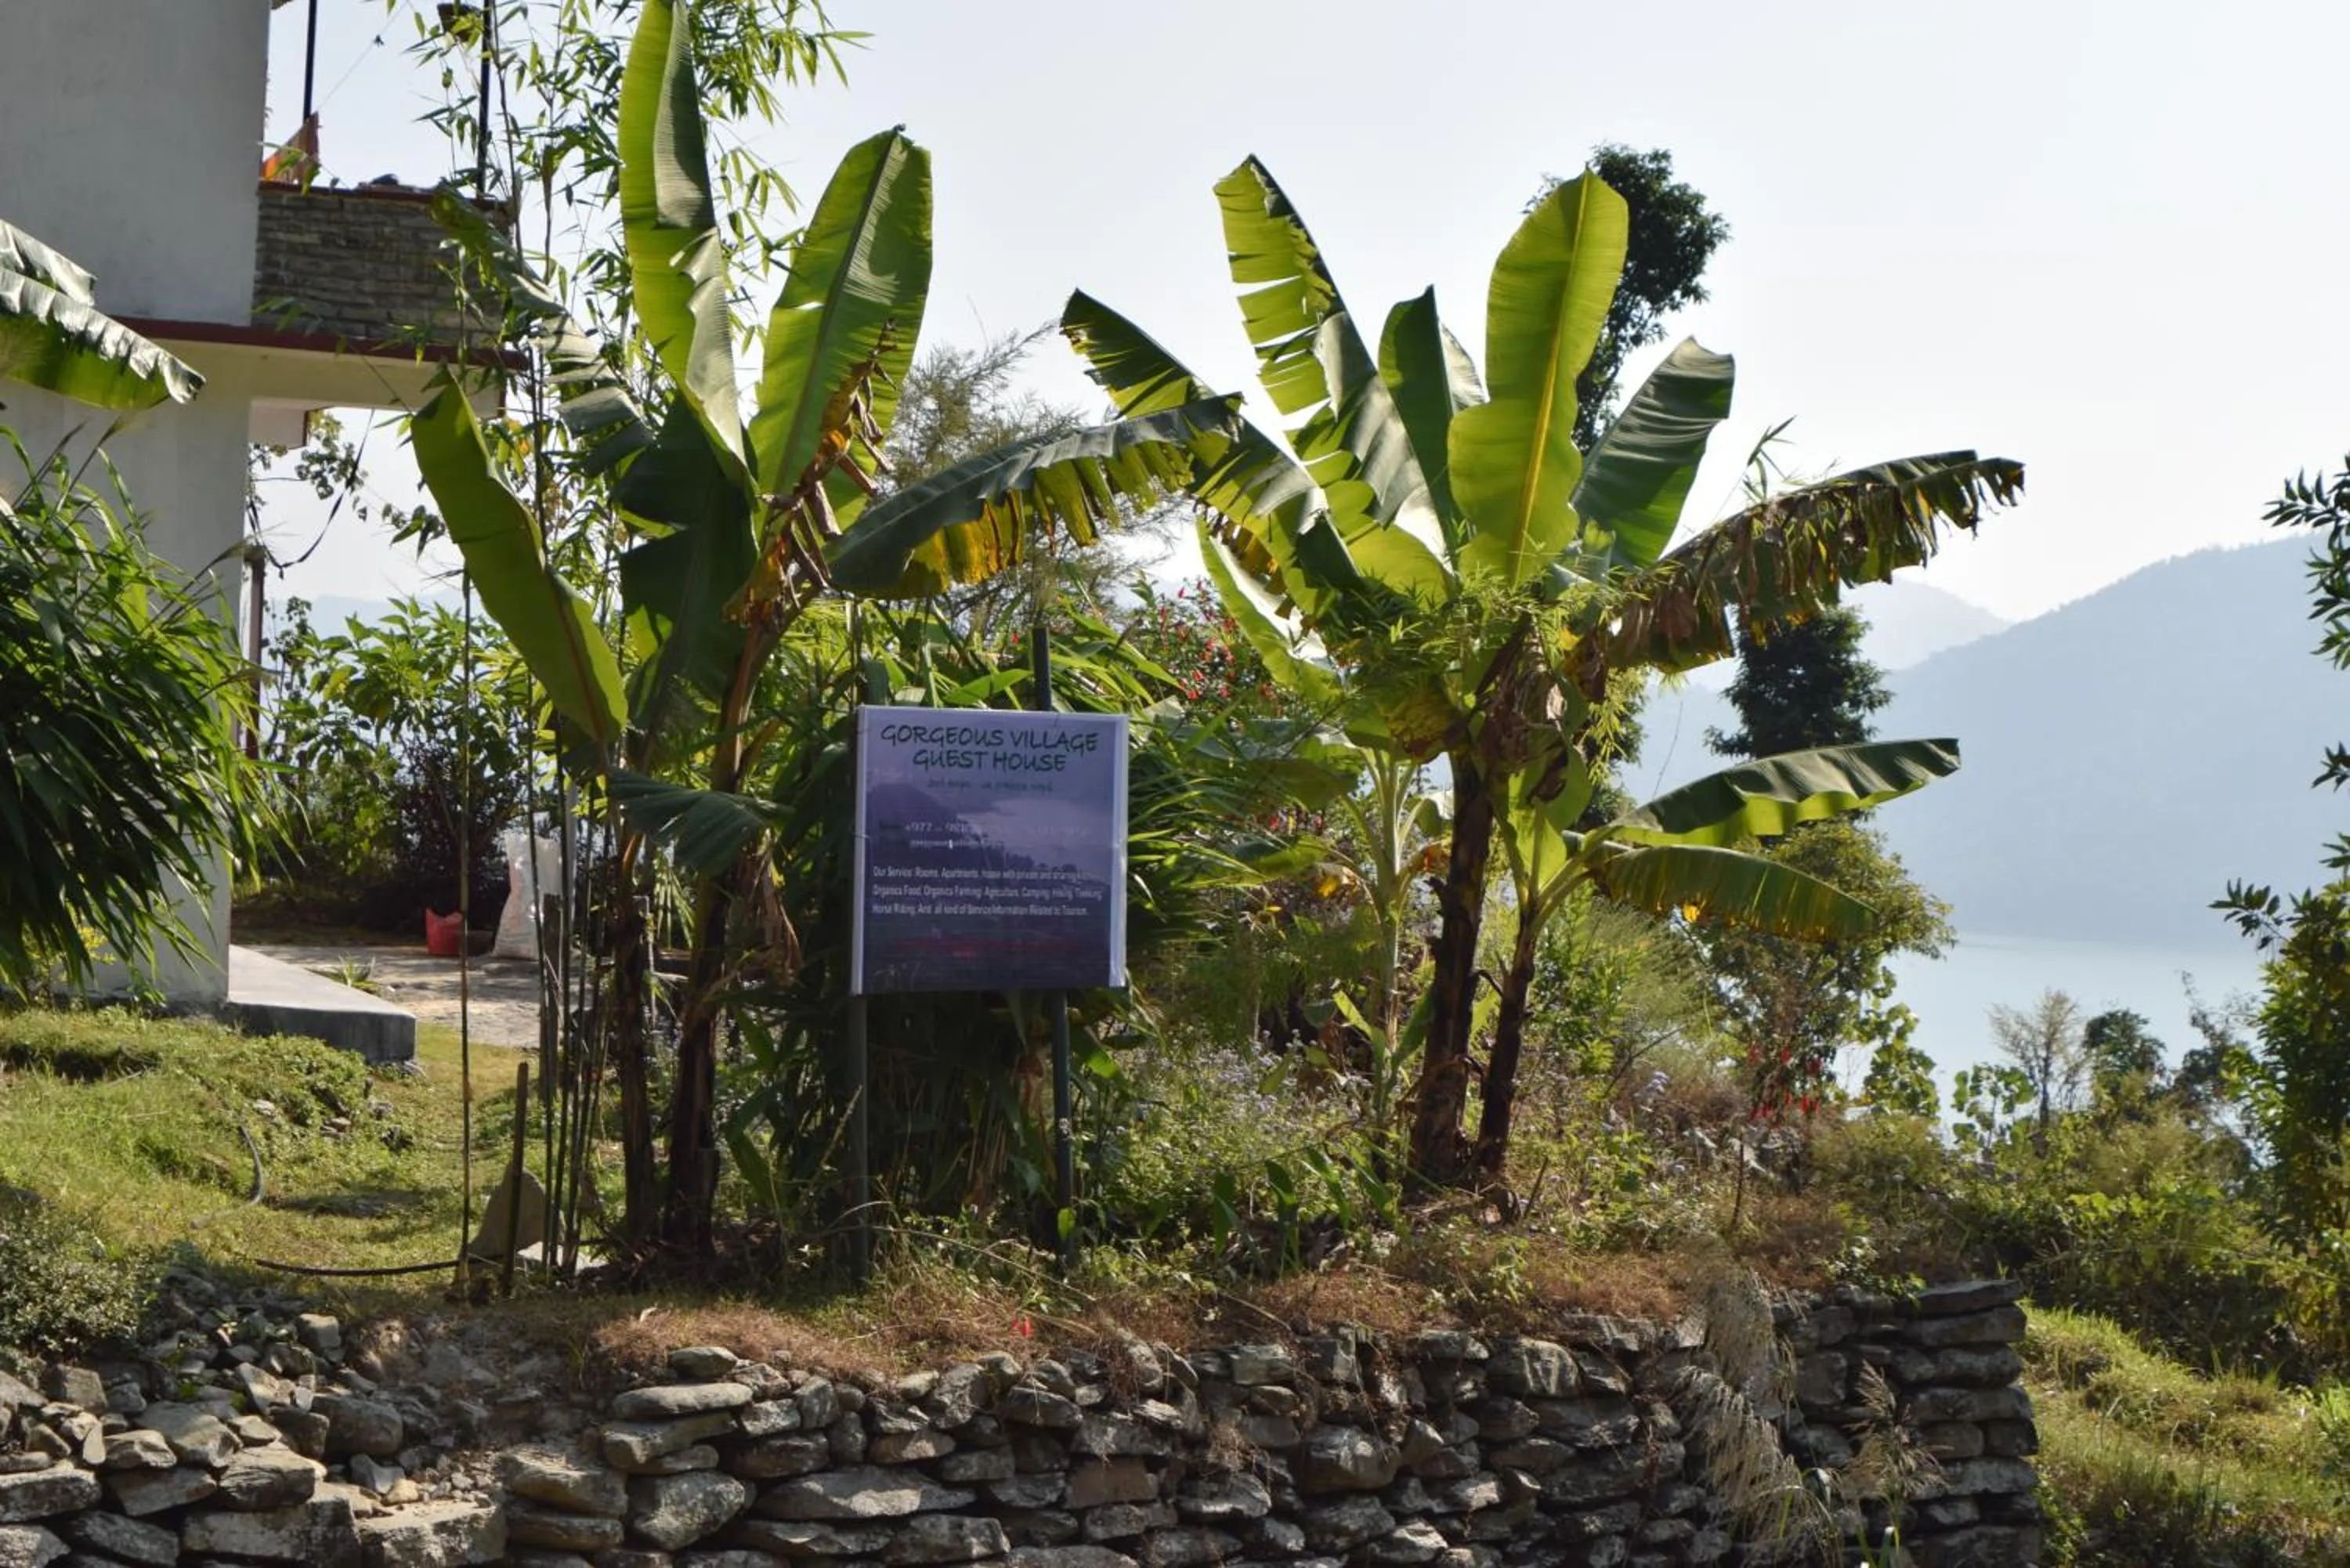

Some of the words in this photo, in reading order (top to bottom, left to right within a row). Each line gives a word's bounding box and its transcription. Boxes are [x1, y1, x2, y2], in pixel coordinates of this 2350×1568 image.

[880, 724, 1003, 746] GORGEOUS
[1009, 729, 1099, 757] VILLAGE
[913, 749, 989, 771] GUEST
[992, 752, 1066, 772] HOUSE
[873, 865, 886, 877] Our
